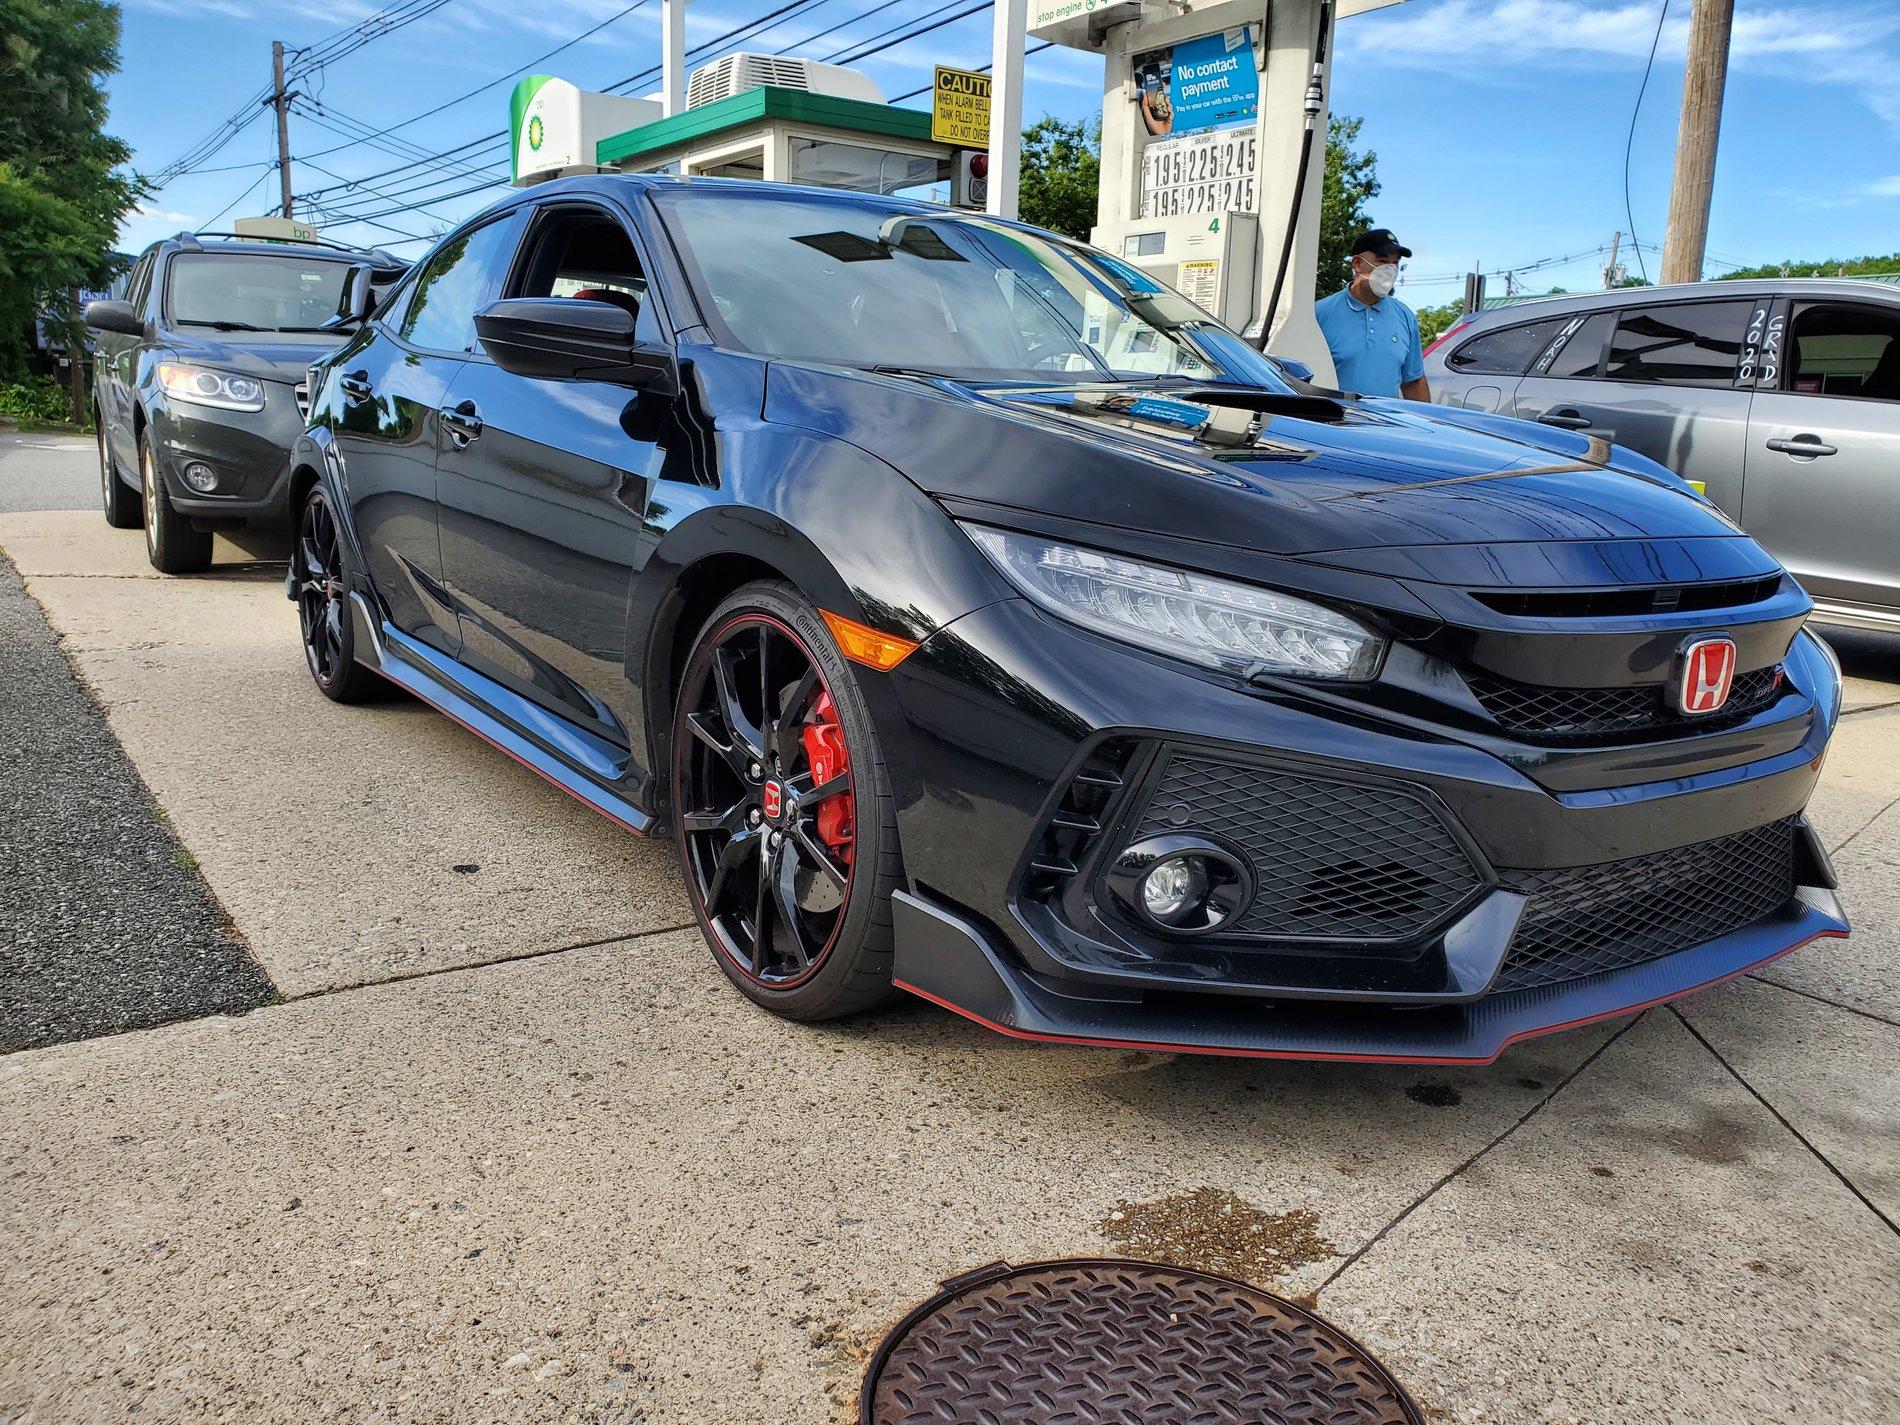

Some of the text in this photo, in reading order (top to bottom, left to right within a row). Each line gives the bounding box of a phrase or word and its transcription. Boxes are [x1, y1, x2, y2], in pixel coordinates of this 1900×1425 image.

[1037, 2, 1082, 23] stop engine
[1178, 56, 1238, 81] No contact
[1181, 75, 1230, 100] payment
[1245, 92, 1256, 100] app
[938, 92, 953, 106] WHEN
[955, 97, 974, 109] ALARM
[940, 107, 953, 120] TANK
[956, 110, 973, 123] FILLED
[975, 113, 981, 125] TO
[950, 124, 958, 136] DO
[960, 126, 972, 138] NOT
[1157, 128, 1254, 151] REGULAR SILVER ULTIMATE
[1154, 152, 1180, 187] 1.95
[1188, 145, 1217, 183] 2.25
[1226, 139, 1256, 177] 2.45
[294, 227, 310, 240] bp
[1208, 218, 1220, 234] 4
[1536, 318, 1585, 370] NOAH
[1740, 309, 1765, 379] 2020
[1762, 315, 1784, 382] GRAD
[795, 613, 834, 668] Continental
